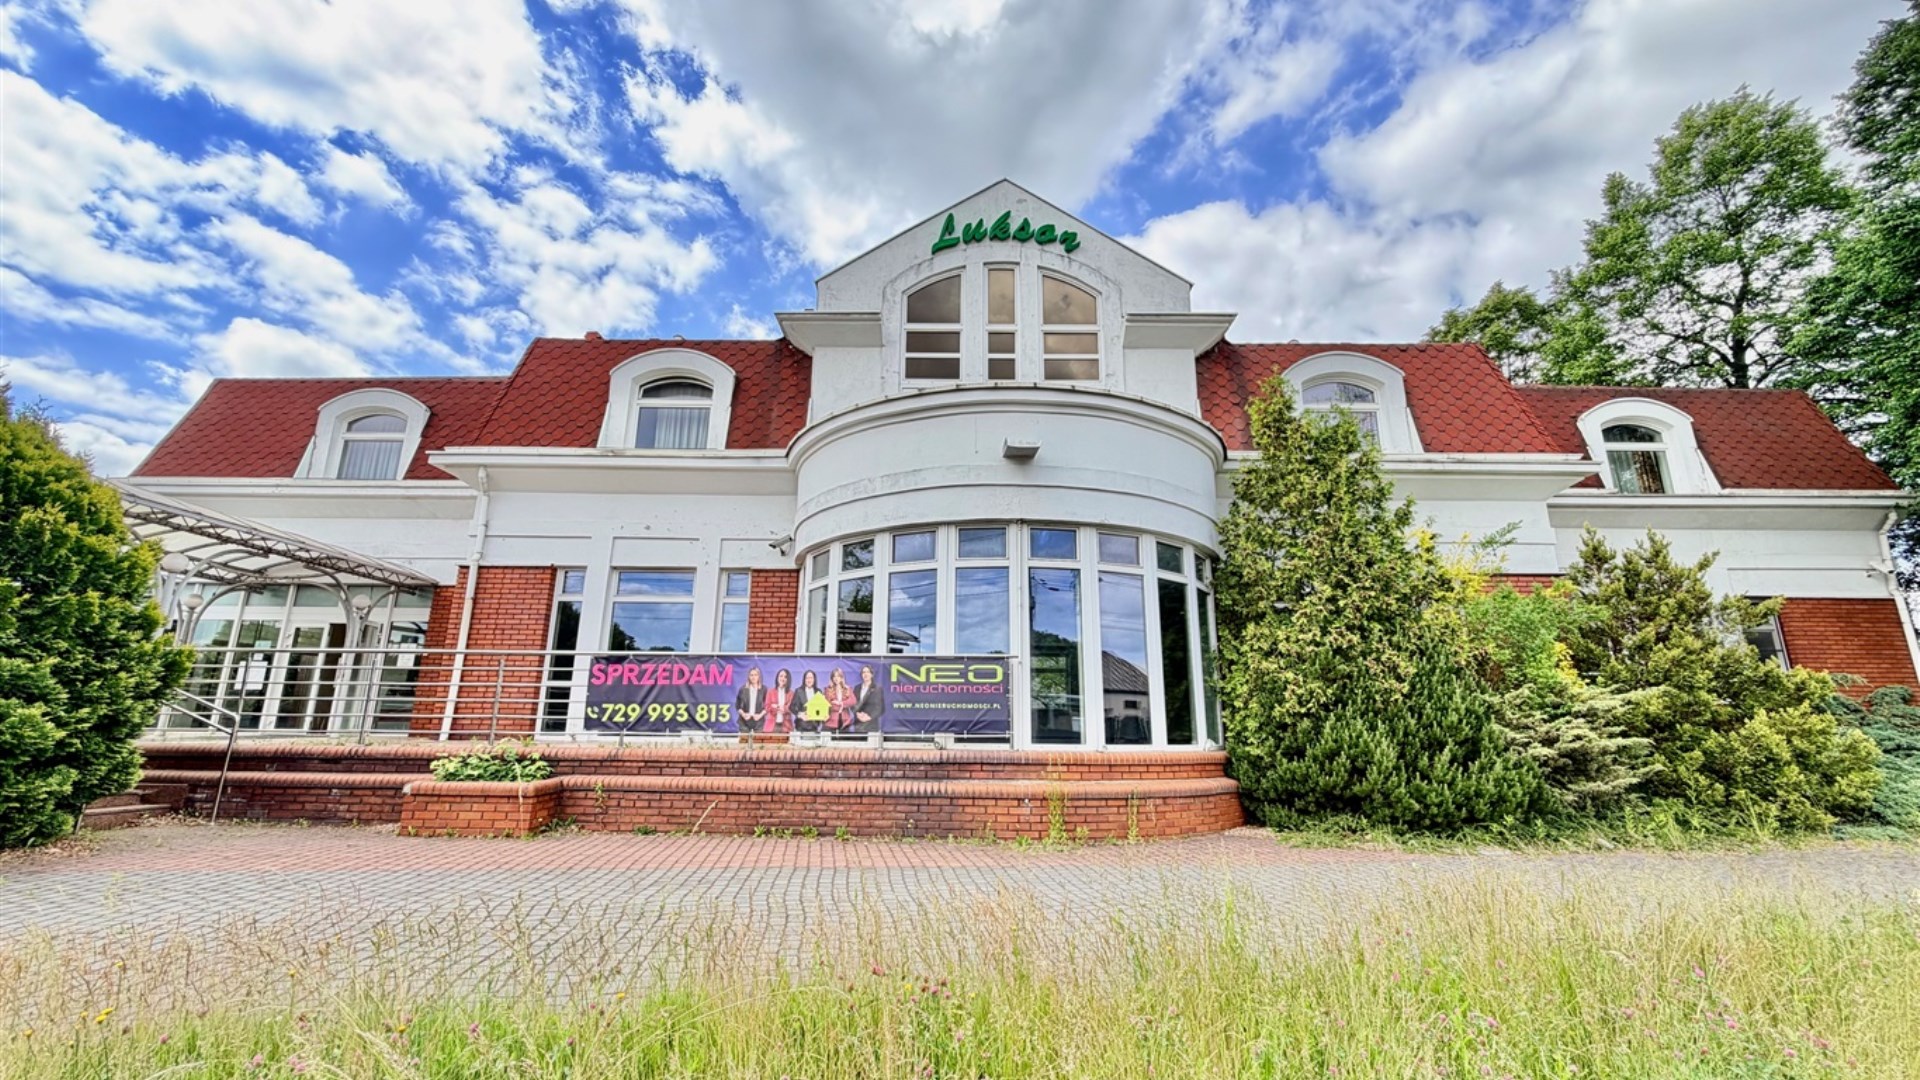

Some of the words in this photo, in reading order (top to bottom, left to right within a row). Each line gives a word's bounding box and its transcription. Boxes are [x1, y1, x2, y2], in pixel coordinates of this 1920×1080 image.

[591, 663, 733, 686] SPRZEDAM
[890, 664, 1003, 682] NEO
[891, 683, 1003, 693] nieruchomości
[601, 703, 641, 723] 729
[647, 703, 689, 723] 993
[695, 703, 731, 723] 813
